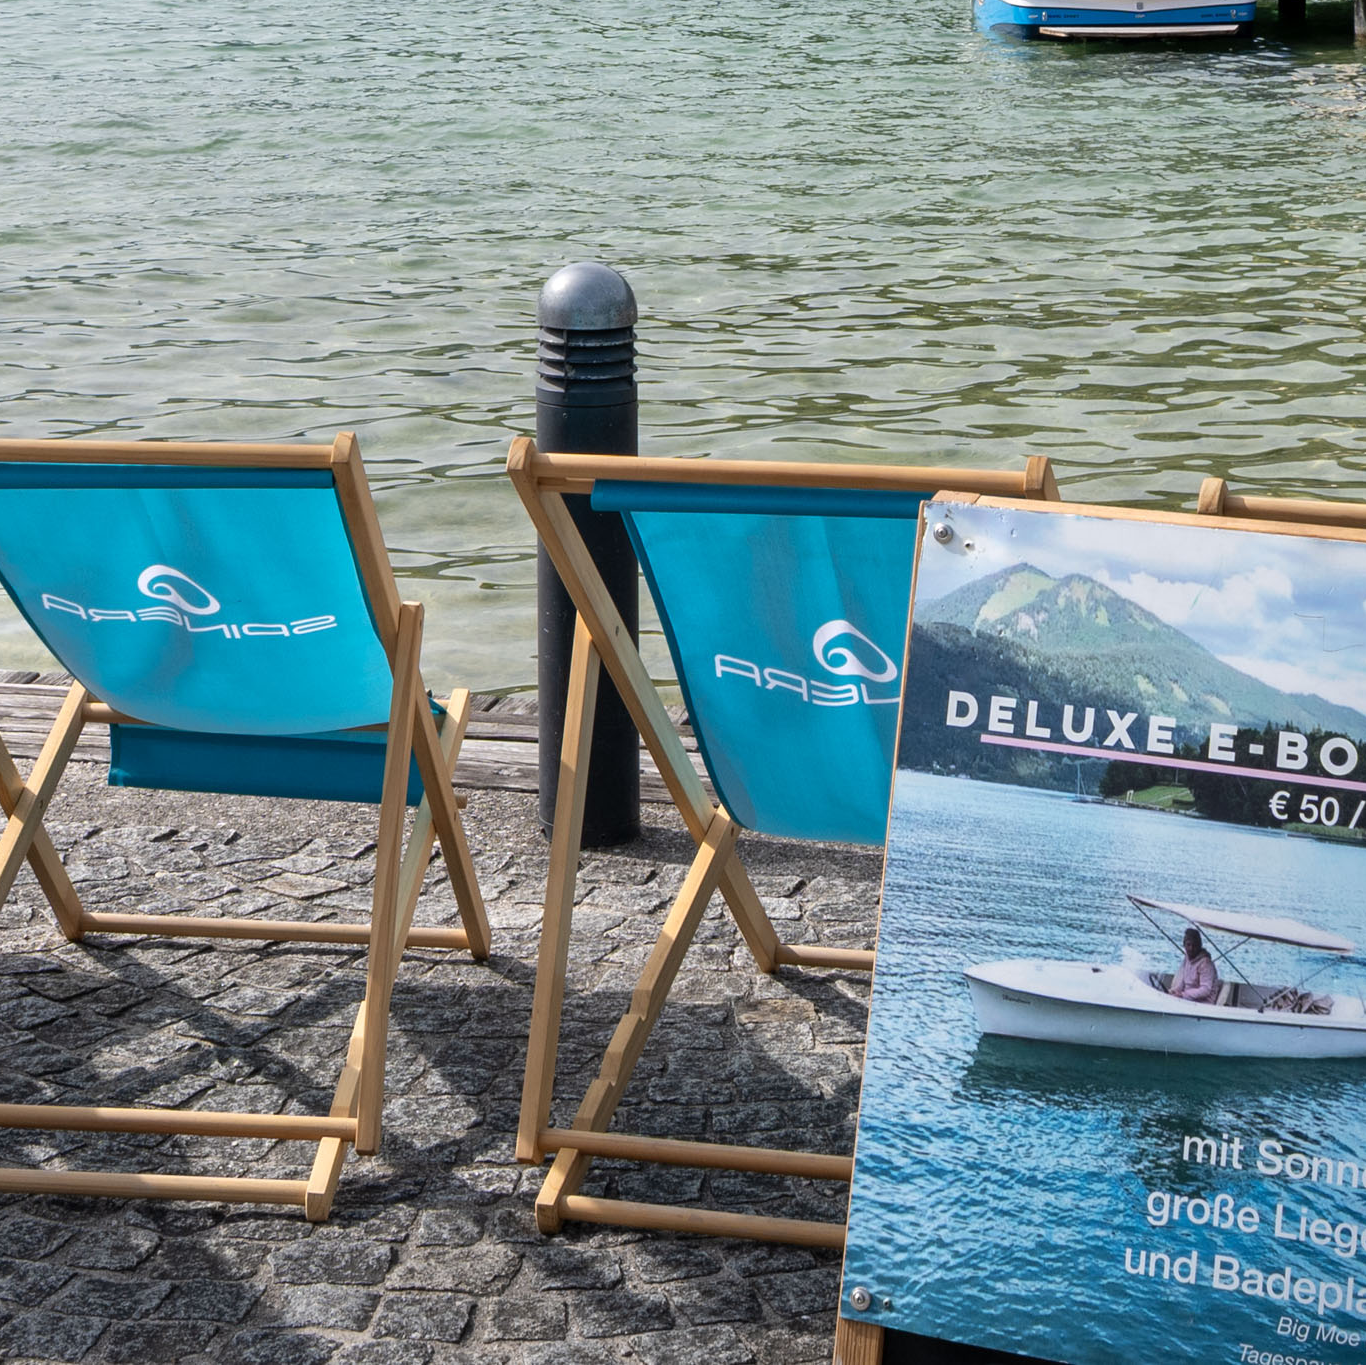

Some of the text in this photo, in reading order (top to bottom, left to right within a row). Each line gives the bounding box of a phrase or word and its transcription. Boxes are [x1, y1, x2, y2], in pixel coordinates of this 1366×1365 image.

[946, 690, 1177, 754] DELUXE
[1268, 791, 1290, 820] €
[1299, 794, 1341, 826] 50
[1348, 800, 1366, 829] /
[1182, 1133, 1244, 1170] mit
[1146, 1190, 1260, 1233] große
[1124, 1247, 1198, 1286] und
[1276, 1316, 1310, 1343] Big
[1315, 1325, 1361, 1347] Moe
